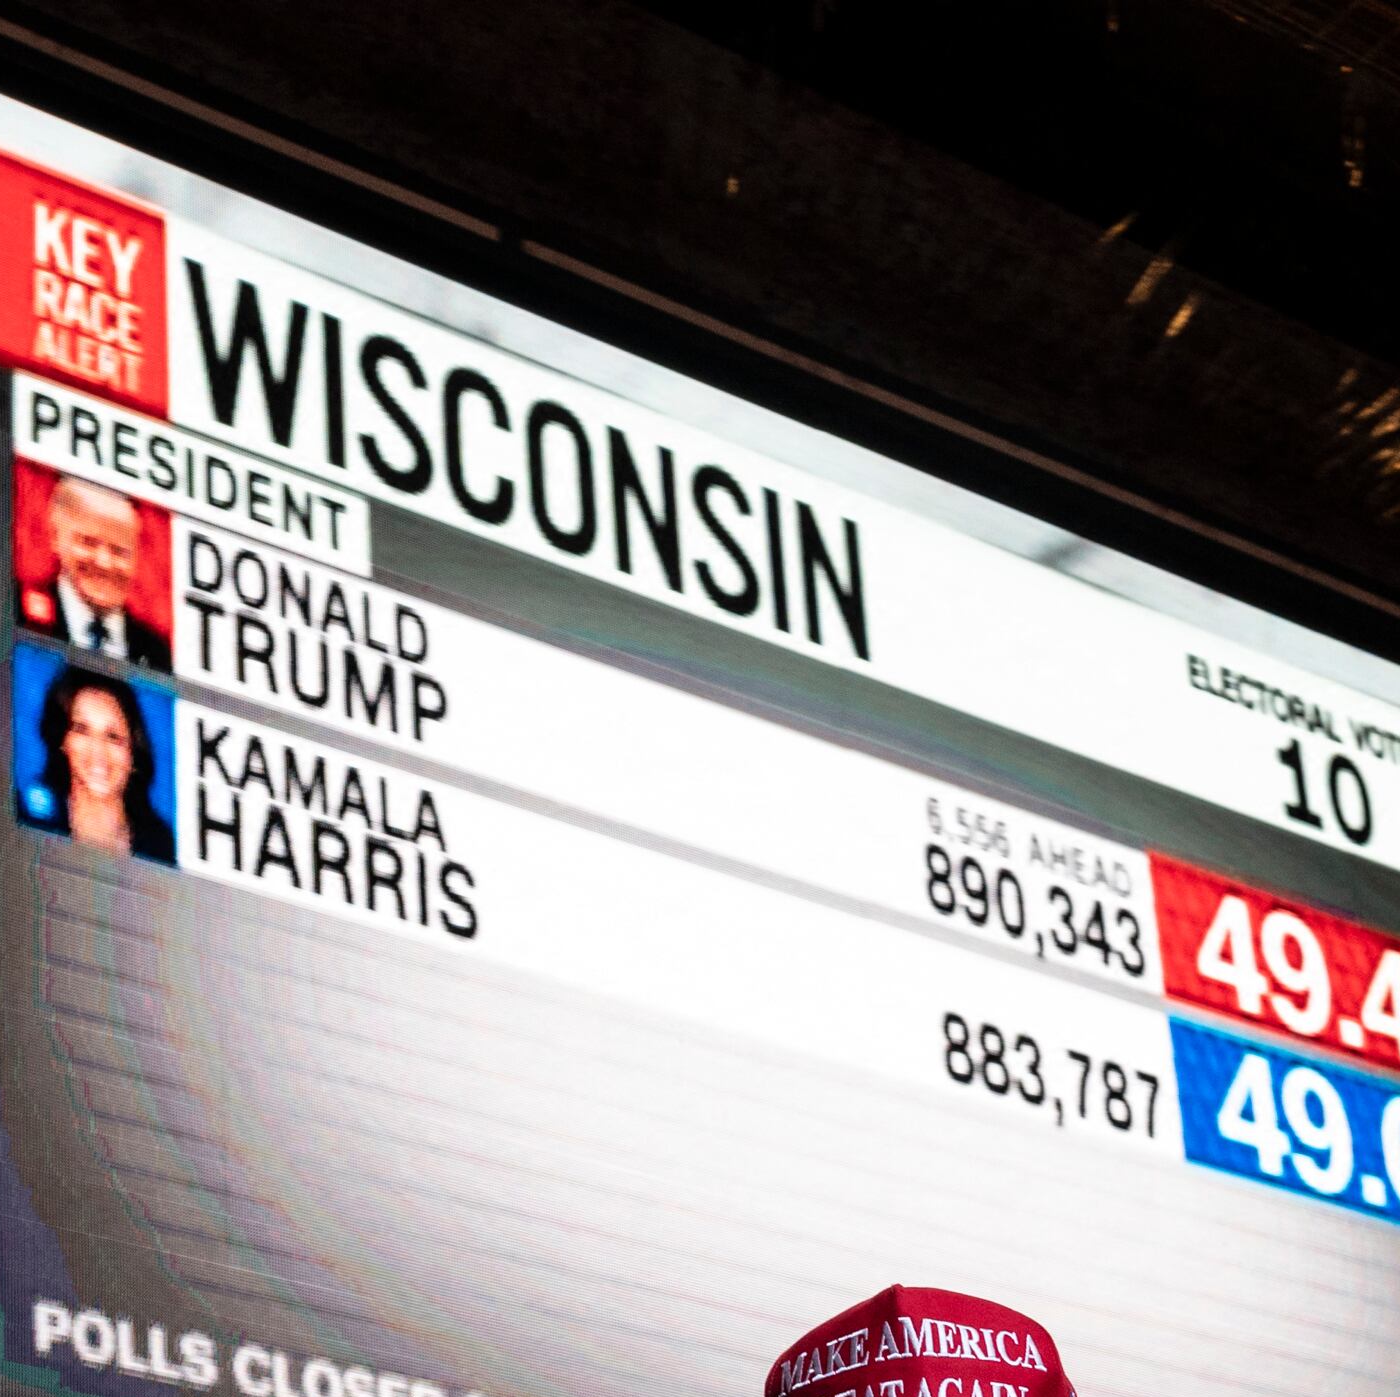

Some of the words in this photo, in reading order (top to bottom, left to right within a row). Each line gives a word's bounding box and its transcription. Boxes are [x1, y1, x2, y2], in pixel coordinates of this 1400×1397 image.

[33, 203, 141, 296] KEY
[34, 267, 144, 353] RACE
[34, 330, 144, 394] ALERT
[32, 392, 347, 549] PRESIDENT
[185, 258, 872, 661] WISCONSIN
[188, 534, 428, 664] DONALD
[185, 595, 448, 742] TRUMP
[1188, 654, 1340, 744] ELECTORAL
[197, 720, 447, 852] KAMALA
[1276, 740, 1373, 846] 10
[198, 787, 480, 940] HARRIS
[927, 844, 1145, 978] 890,343
[1030, 832, 1133, 898] AHEAD
[943, 1012, 1161, 1140] 883,787
[34, 1301, 219, 1387] POLLS
[778, 1328, 869, 1397] MAKE
[875, 1317, 1047, 1372] AMERICA
